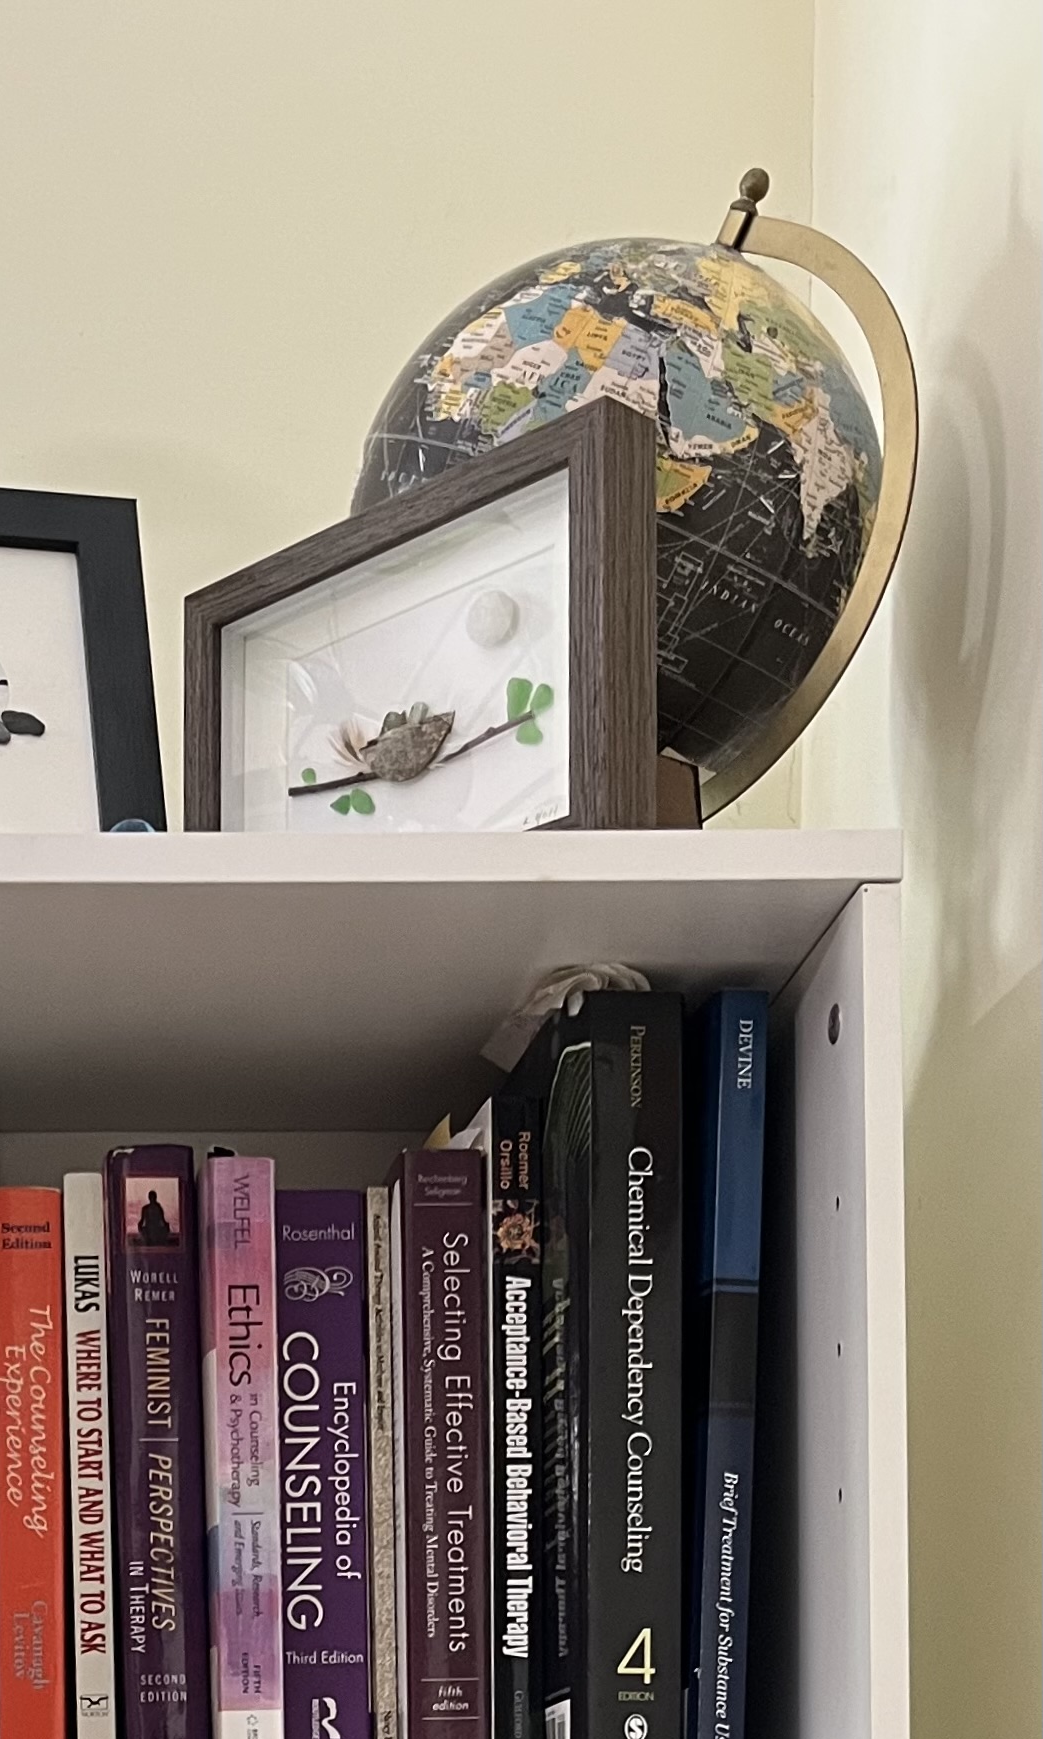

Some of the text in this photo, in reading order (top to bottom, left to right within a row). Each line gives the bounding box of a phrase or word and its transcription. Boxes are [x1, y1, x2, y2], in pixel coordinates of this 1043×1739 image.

[736, 1019, 753, 1089] DEVINE
[282, 1222, 355, 1241] Rosenthal
[74, 1256, 100, 1313] LUKAS
[227, 1284, 262, 1387] Ethics
[620, 1147, 653, 1573] Chemical Dependency Counseling
[145, 1318, 175, 1631] FEMINIST PERSPECTIVES
[282, 1331, 324, 1630] COUNSELING
[327, 1382, 361, 1579] Encyclopedia of
[437, 1232, 472, 1652] Selecting Effective Treatments
[502, 1276, 533, 1657] Acceptance-Based Behavioral Therapy
[75, 1330, 106, 1654] WHERE TO START AND WHAT TO ASK
[721, 1472, 739, 1515] Brief
[720, 1517, 736, 1602] Treatment
[618, 1628, 655, 1684] 4
[716, 1603, 735, 1631] for
[714, 1635, 731, 1719] Substance
